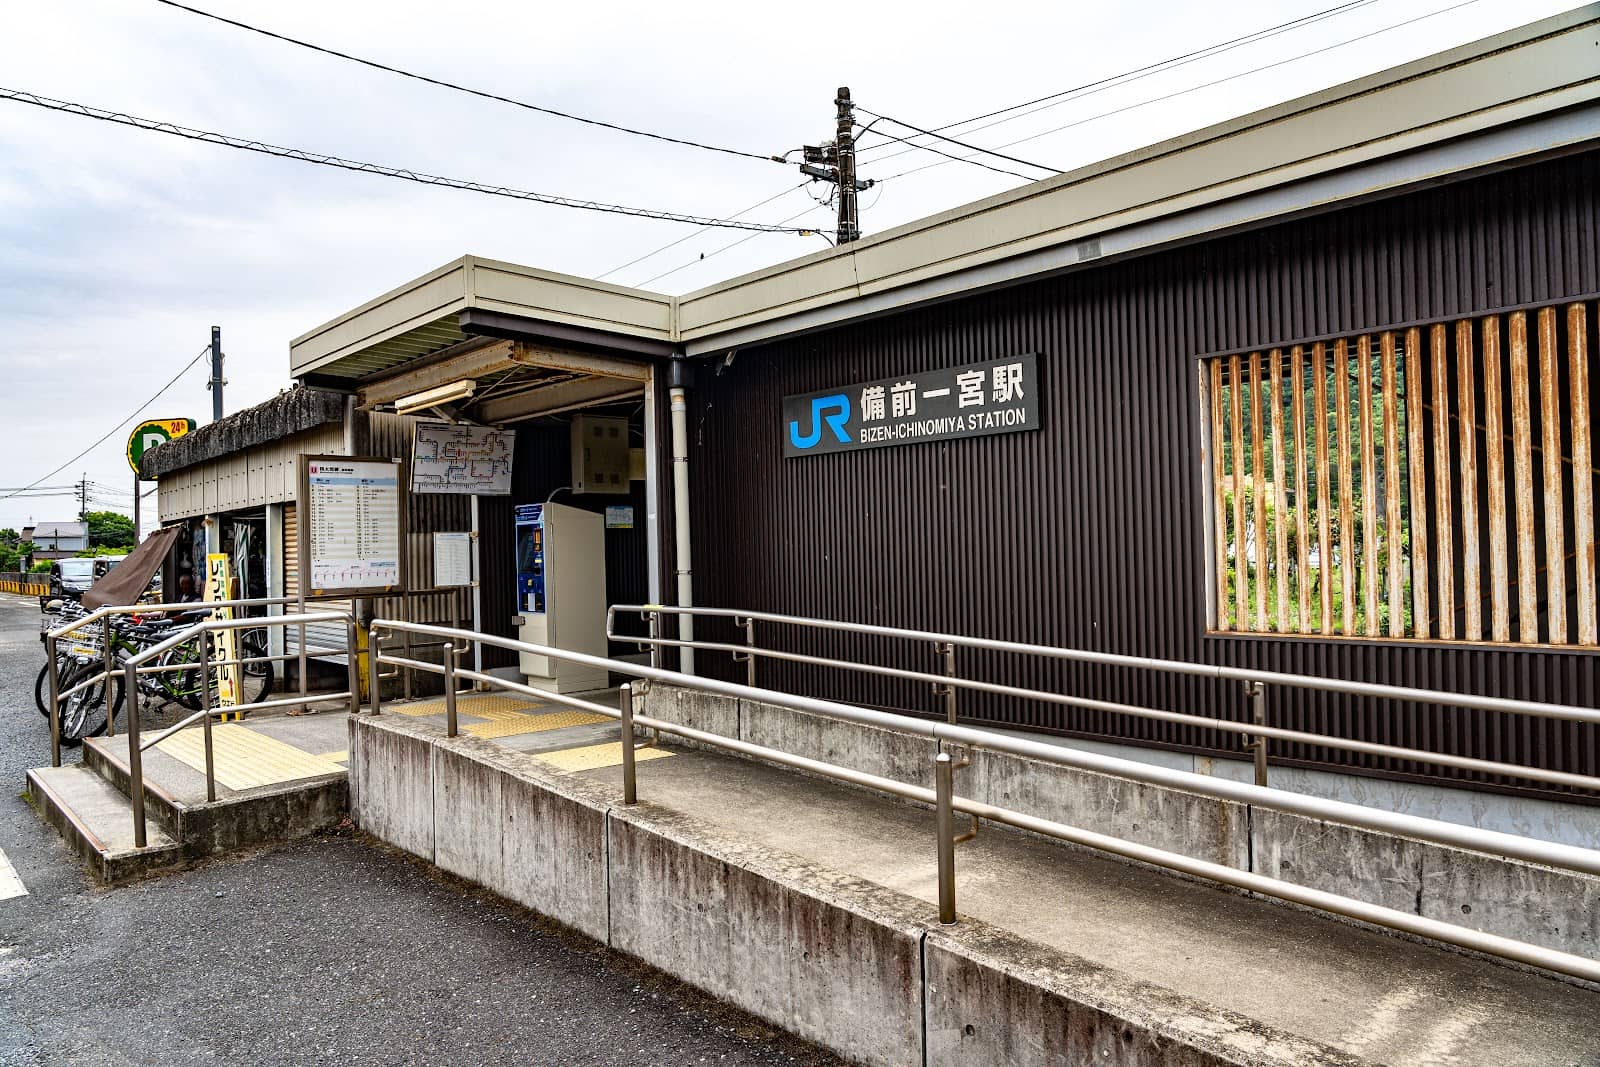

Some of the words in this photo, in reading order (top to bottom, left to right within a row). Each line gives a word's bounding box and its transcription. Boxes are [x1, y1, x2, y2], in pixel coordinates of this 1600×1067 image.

[860, 363, 1024, 422] 備前一宮駅
[789, 394, 852, 448] JR
[860, 417, 964, 443] BIZEN-ICHINOMIYA
[968, 407, 1025, 430] STATION
